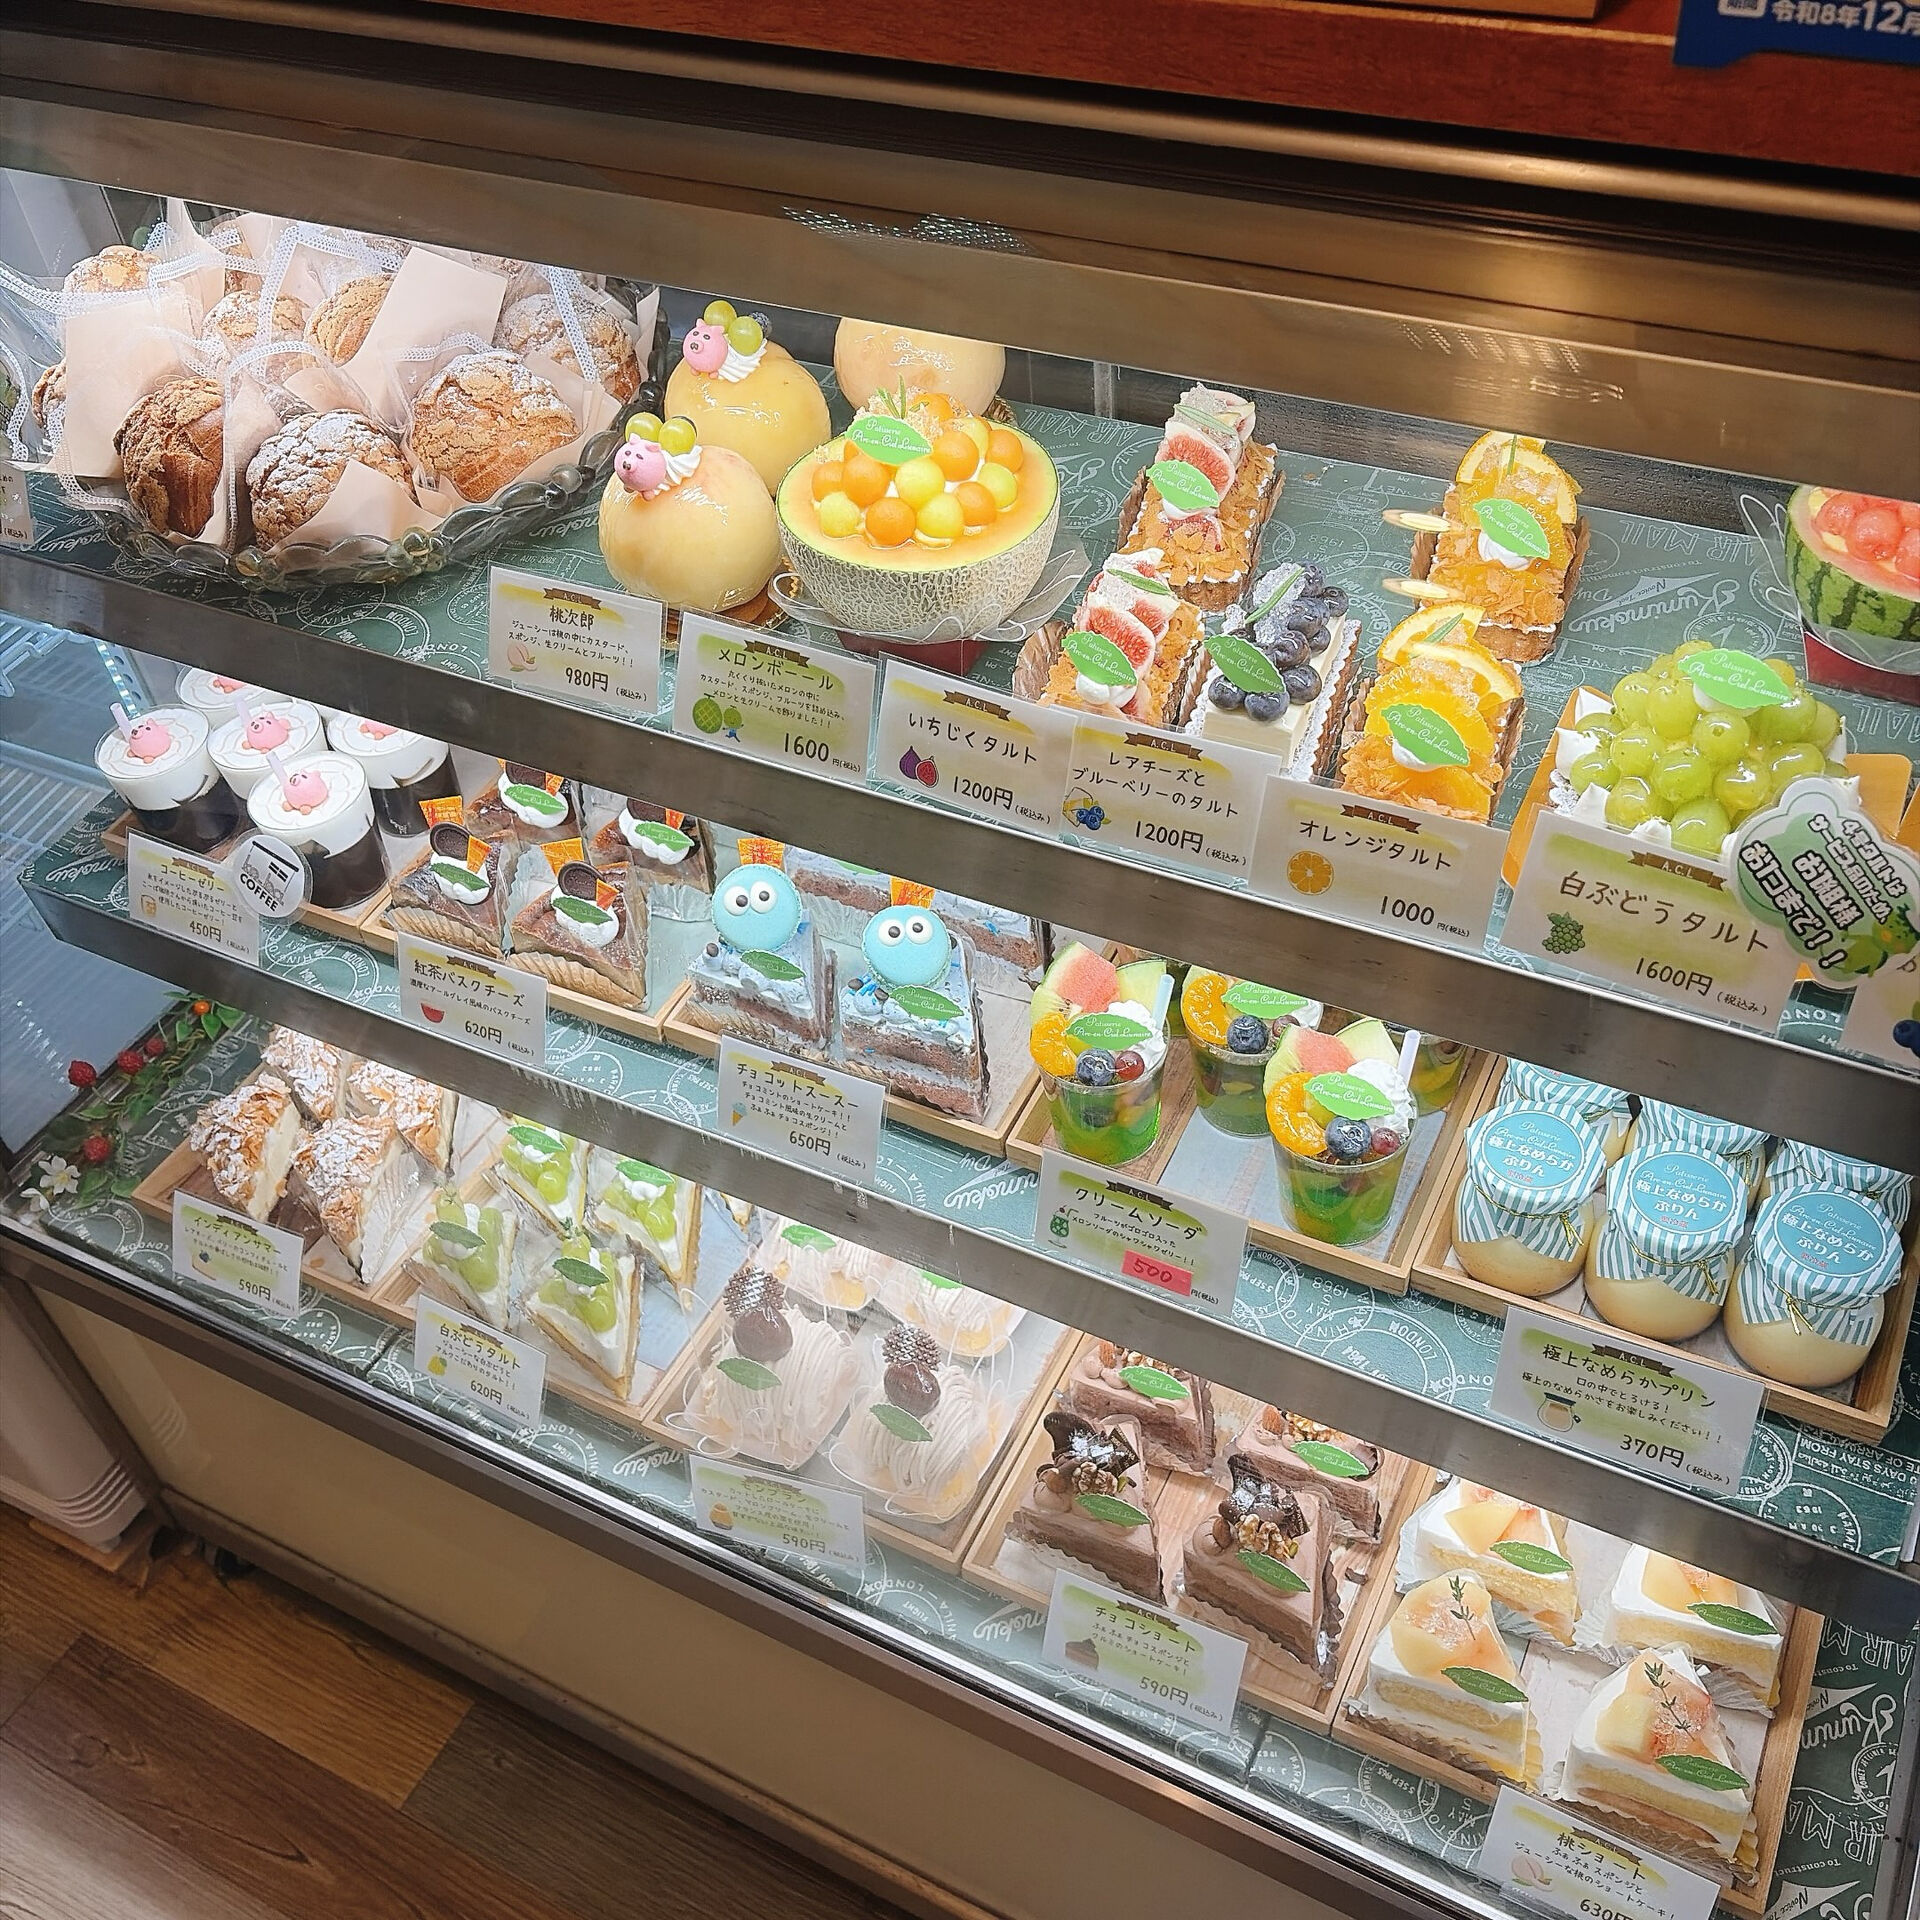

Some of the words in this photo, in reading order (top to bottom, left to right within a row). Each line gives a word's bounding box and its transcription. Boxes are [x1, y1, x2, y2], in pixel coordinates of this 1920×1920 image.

[1620, 519, 1700, 556] MAIL
[550, 605, 594, 630] 桃次郎
[565, 667, 609, 693] 980円
[965, 697, 988, 712] A.C.L
[784, 733, 830, 762] 1600
[909, 713, 1038, 764] いちじくタルト
[1151, 739, 1175, 751] A.C.L
[1109, 752, 1206, 787] レアチーズと
[953, 776, 1014, 810] 1200円
[1072, 767, 1239, 818] ブルーベリーのタルト
[1015, 805, 1051, 825] (税込み)
[1367, 811, 1394, 825] A.C.L
[1135, 821, 1204, 854] 1200円
[1299, 820, 1452, 871] オレンジタルト
[1205, 847, 1248, 866] (税込み)
[1661, 861, 1696, 879] A.C.L
[1807, 813, 1894, 925] サービス品のため、
[1841, 819, 1908, 899] 4号タルトは
[160, 863, 226, 893] コーヒーゼリー
[239, 872, 279, 912] COFFEE
[1792, 849, 1865, 931] お1組様
[1380, 896, 1435, 926] 1000
[1559, 870, 1769, 953] 白ぶどうタルト
[189, 920, 222, 943] 450円
[414, 959, 526, 1007] 紅茶バスクチーズ
[1635, 957, 1714, 997] 1600円
[1717, 990, 1769, 1016] (税込み)
[465, 1020, 502, 1046] 620円
[736, 1063, 860, 1109] チョコットスースー
[745, 1092, 848, 1132] チョコミント風味の生クリームと
[789, 1131, 832, 1157] 650円
[1488, 1135, 1576, 1172] 極上なめらか
[1502, 1155, 1546, 1178] ぷりん
[1635, 1178, 1728, 1213] 極上なめらか
[1653, 1199, 1700, 1222] ぷりん
[1076, 1187, 1203, 1240] クリームソーダ
[1093, 1212, 1177, 1248] フルーツがゴロゴロ入った
[1782, 1213, 1875, 1261] 極上なめらか
[1797, 1236, 1841, 1265] ぷりん
[1132, 1257, 1173, 1284] 500
[239, 1279, 271, 1302] 590円
[1312, 1276, 1350, 1300] 1968
[440, 1323, 521, 1370] 白ぶどうタルト
[1542, 1343, 1716, 1408] 極上なめらかプリン
[470, 1380, 503, 1405] 620円
[1522, 1371, 1722, 1444] 極上のなめらかさをお楽しみください！！
[1576, 1376, 1670, 1414] 口の中でとろける！
[1619, 1434, 1686, 1468] 370円
[1800, 1437, 1838, 1458] FROM
[1839, 1451, 1871, 1470] STAY
[1873, 1464, 1907, 1483] DAYS
[783, 1533, 826, 1554] 590円
[1095, 1606, 1196, 1654] チョコショート
[1139, 1676, 1189, 1706] 590円
[1557, 1831, 1646, 1881] 桃ショート
